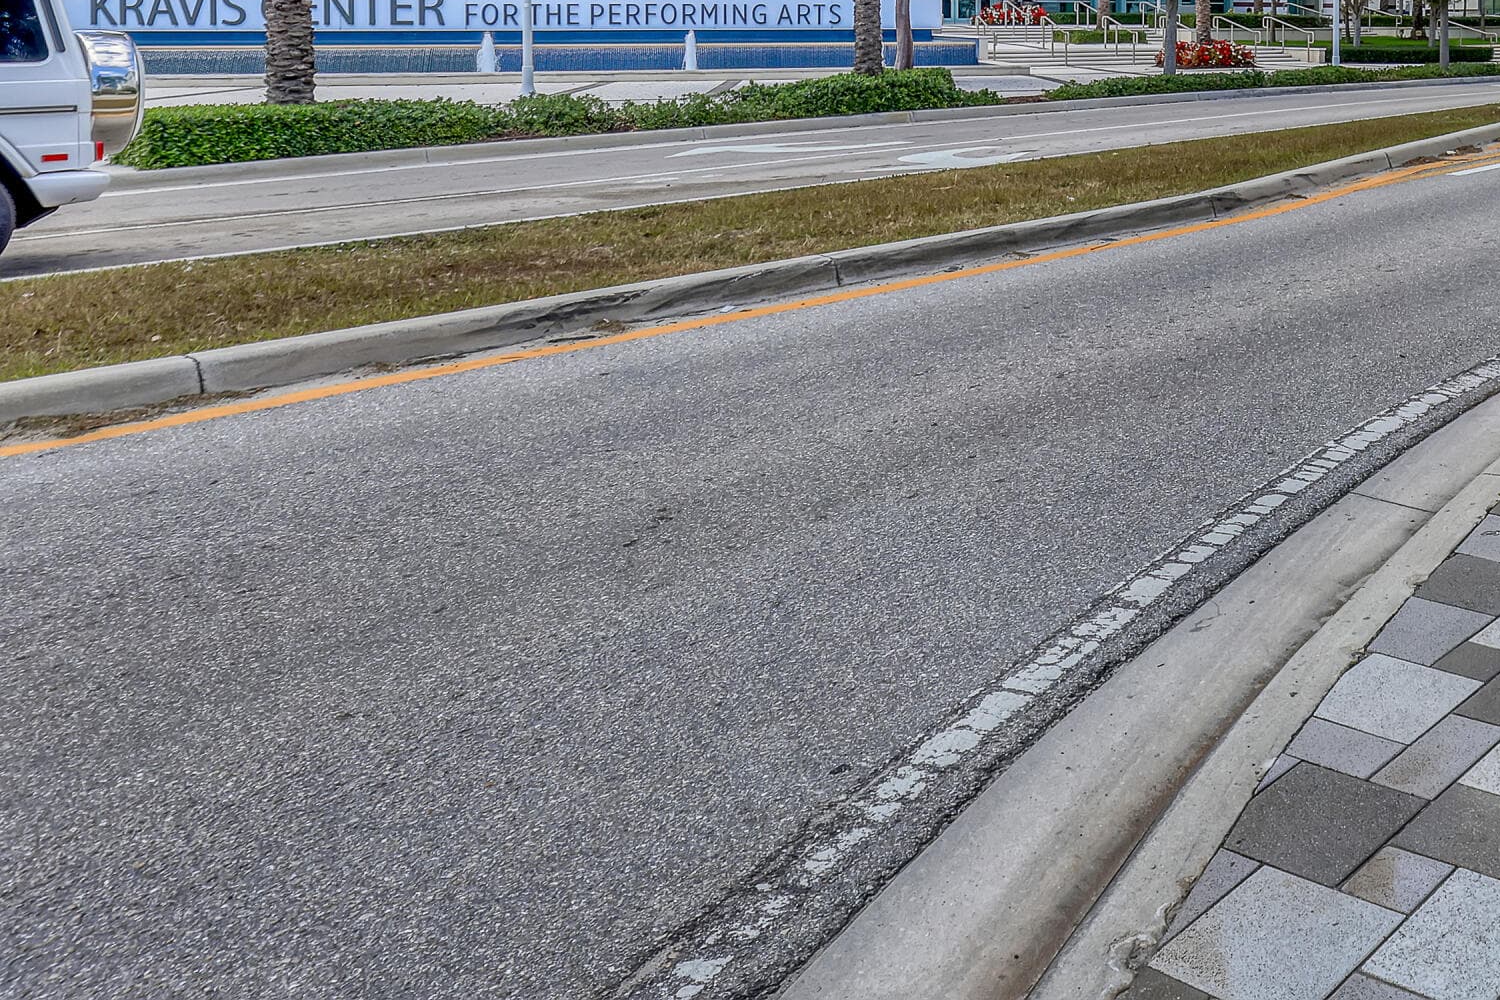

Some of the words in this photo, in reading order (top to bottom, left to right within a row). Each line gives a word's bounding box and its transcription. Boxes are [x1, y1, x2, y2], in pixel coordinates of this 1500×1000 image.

[465, 3, 520, 26] FOR
[531, 3, 580, 26] THE
[590, 3, 768, 26] PERFORMING
[777, 3, 842, 26] ARTS
